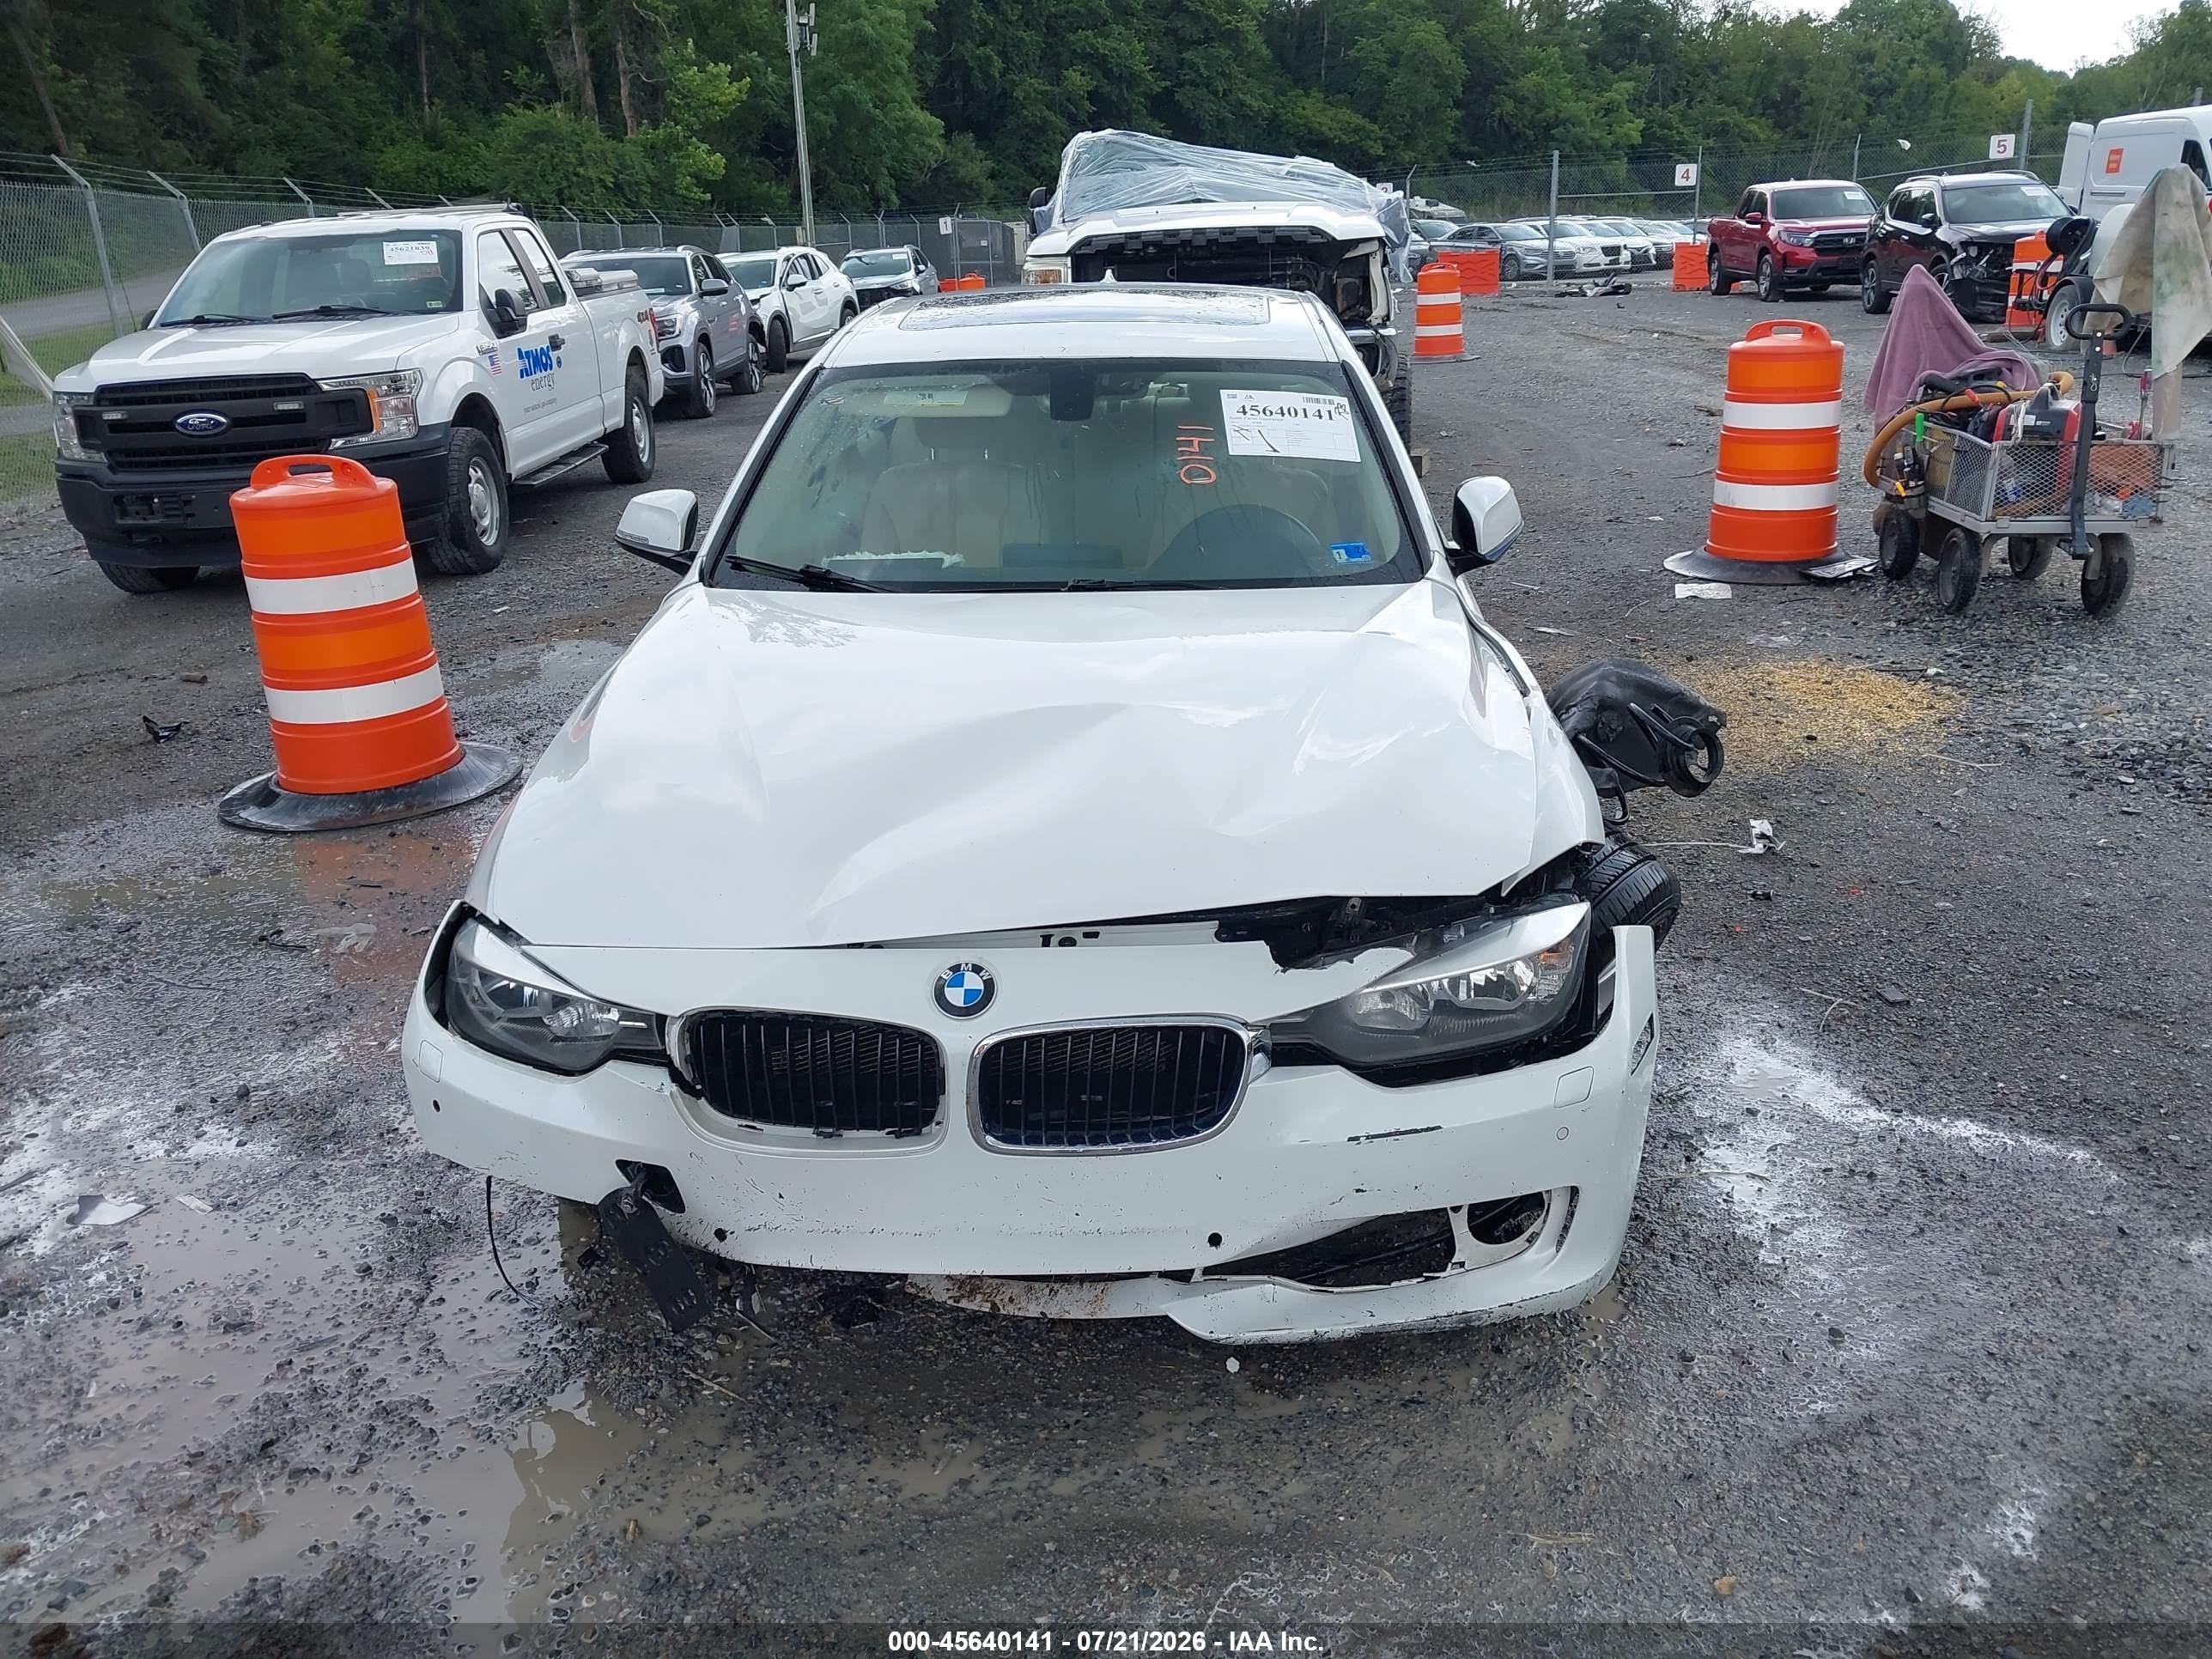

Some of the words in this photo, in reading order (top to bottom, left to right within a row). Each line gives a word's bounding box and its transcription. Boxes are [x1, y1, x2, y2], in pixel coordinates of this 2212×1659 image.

[1997, 139, 2008, 154] 5
[1680, 168, 1691, 182] 4
[943, 220, 948, 231] 1
[517, 345, 553, 379] ATMOS
[531, 373, 555, 391] energy
[1236, 404, 1337, 421] 45640141
[187, 417, 216, 430] Ford
[940, 963, 992, 981] BMW
